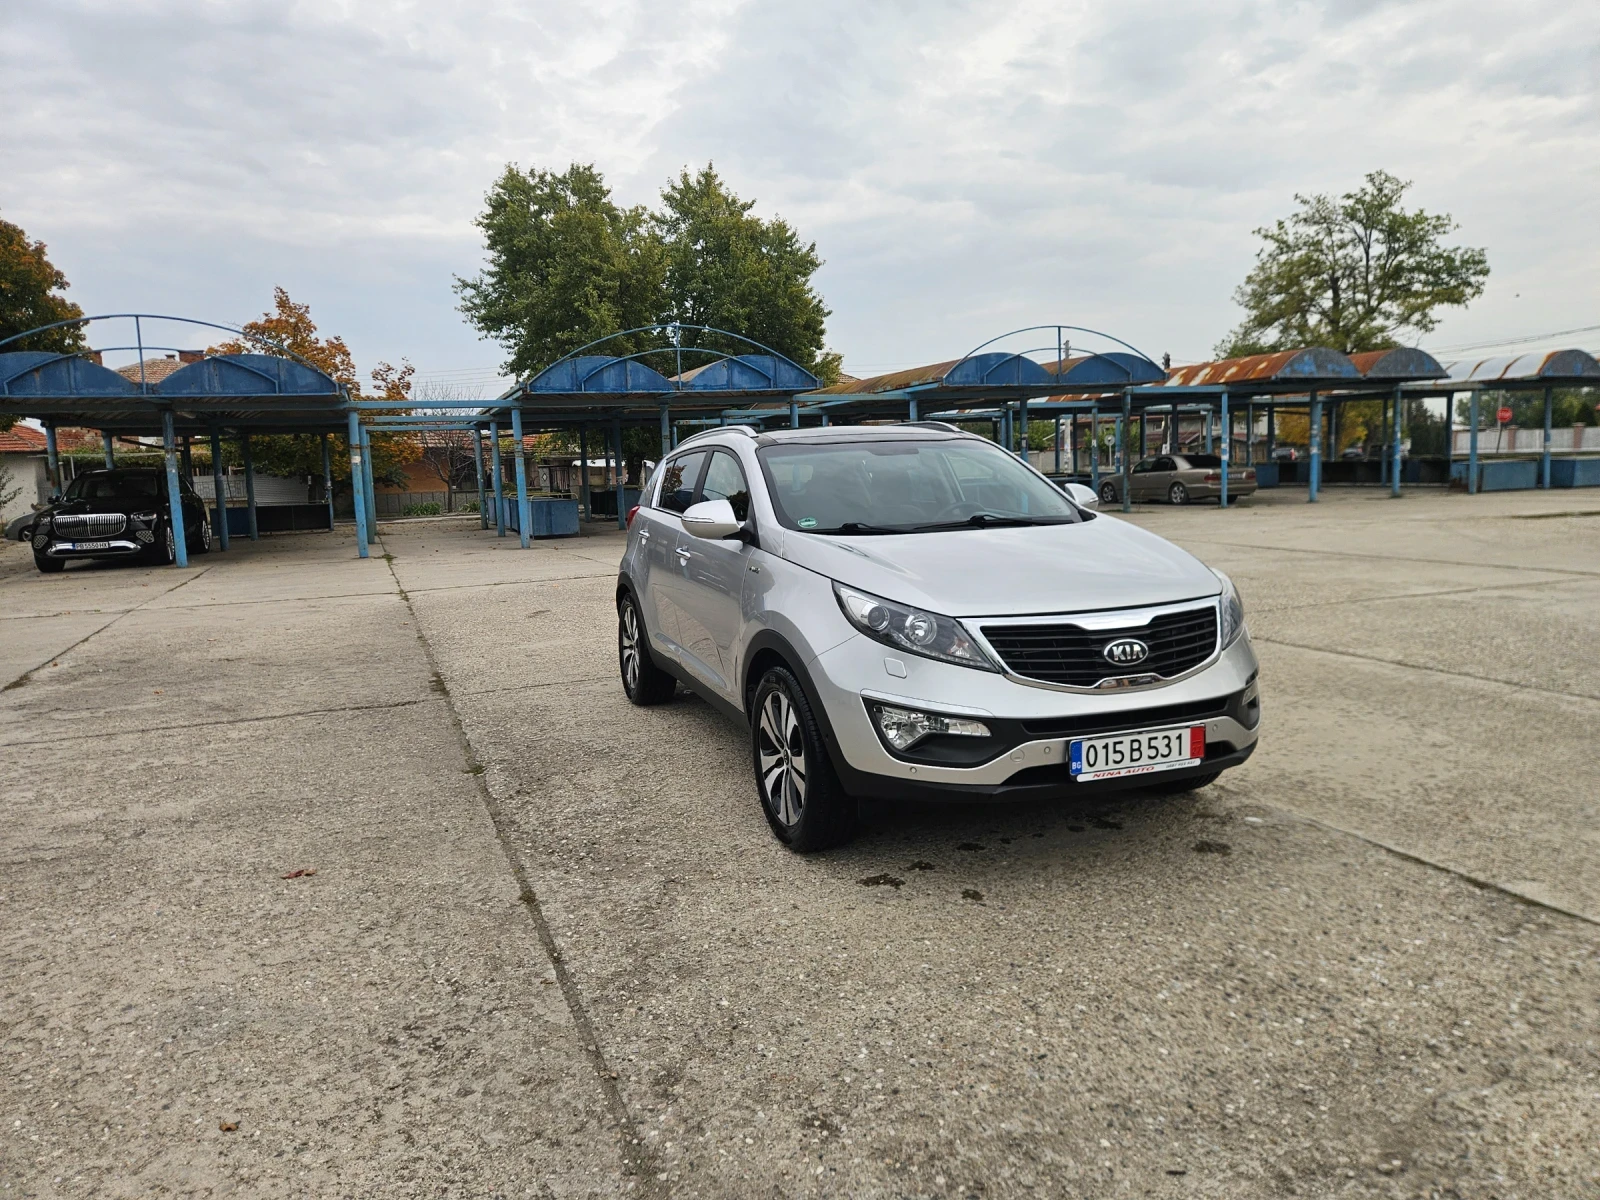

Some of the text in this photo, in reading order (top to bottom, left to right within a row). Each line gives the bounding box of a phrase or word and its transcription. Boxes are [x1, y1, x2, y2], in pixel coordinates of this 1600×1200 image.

[1112, 644, 1143, 661] KIA
[1071, 762, 1082, 770] BG
[1124, 766, 1155, 774] AUTO
